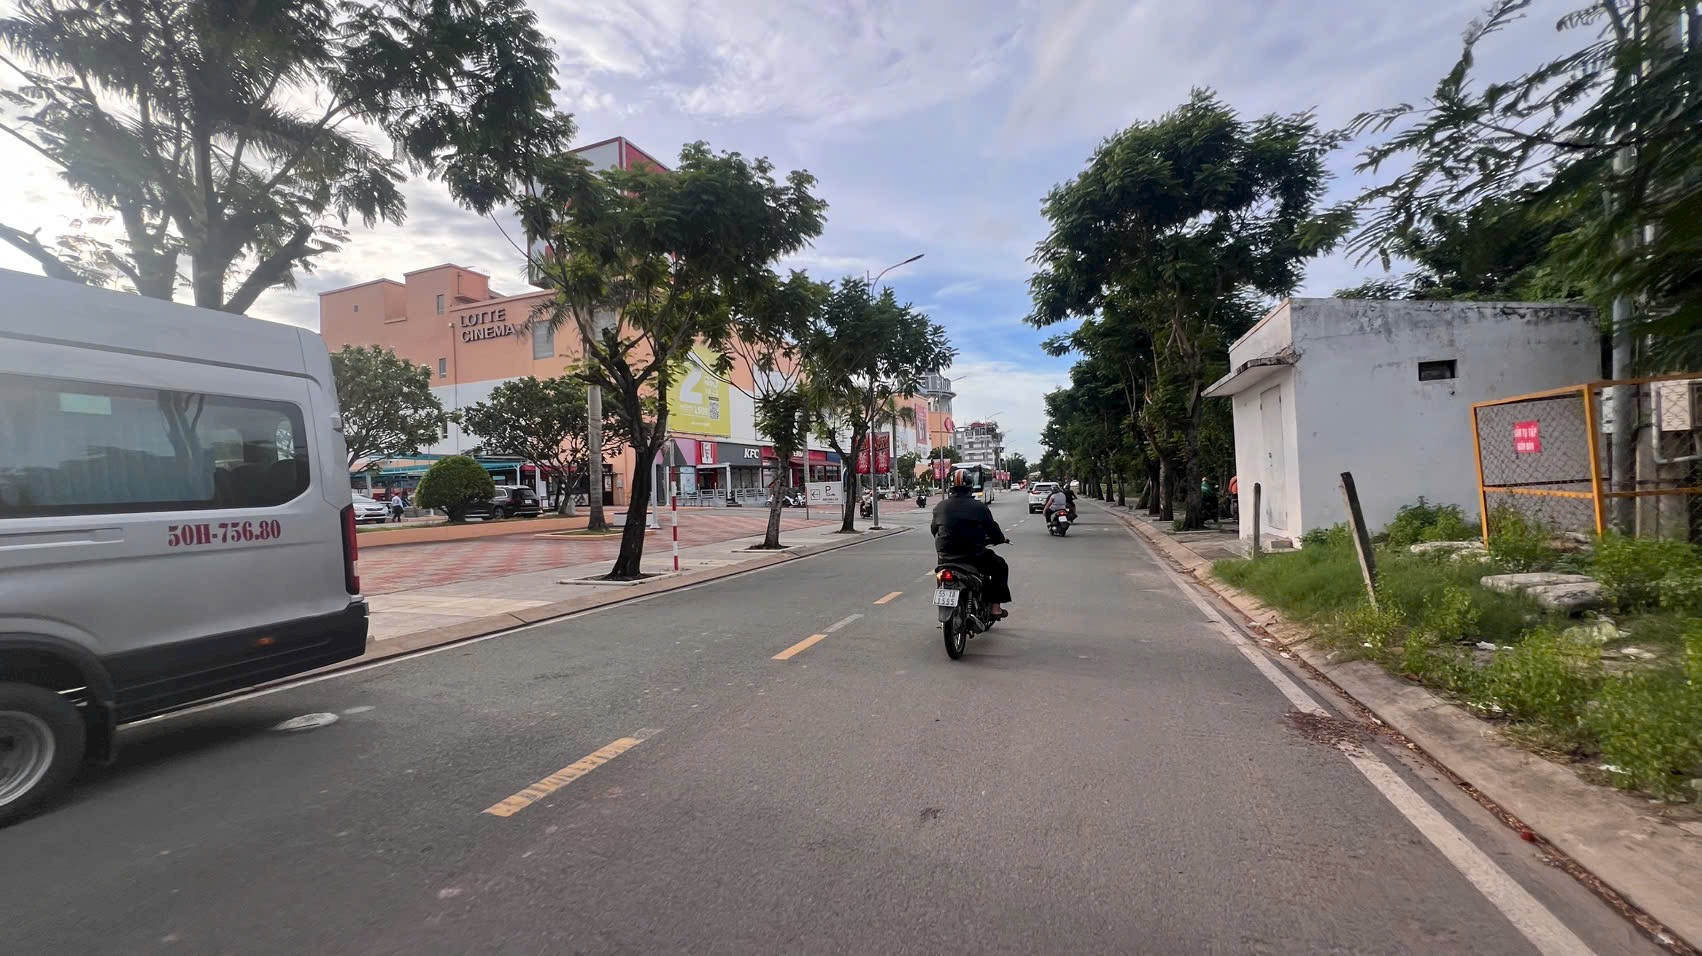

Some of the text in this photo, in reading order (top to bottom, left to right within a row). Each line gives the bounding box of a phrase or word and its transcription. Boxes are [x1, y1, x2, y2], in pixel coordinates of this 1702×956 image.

[460, 309, 506, 327] LOTTE
[461, 324, 516, 343] CINEMA
[744, 448, 760, 459] KFC
[825, 485, 832, 494] P
[168, 519, 281, 547] 50H-756.80
